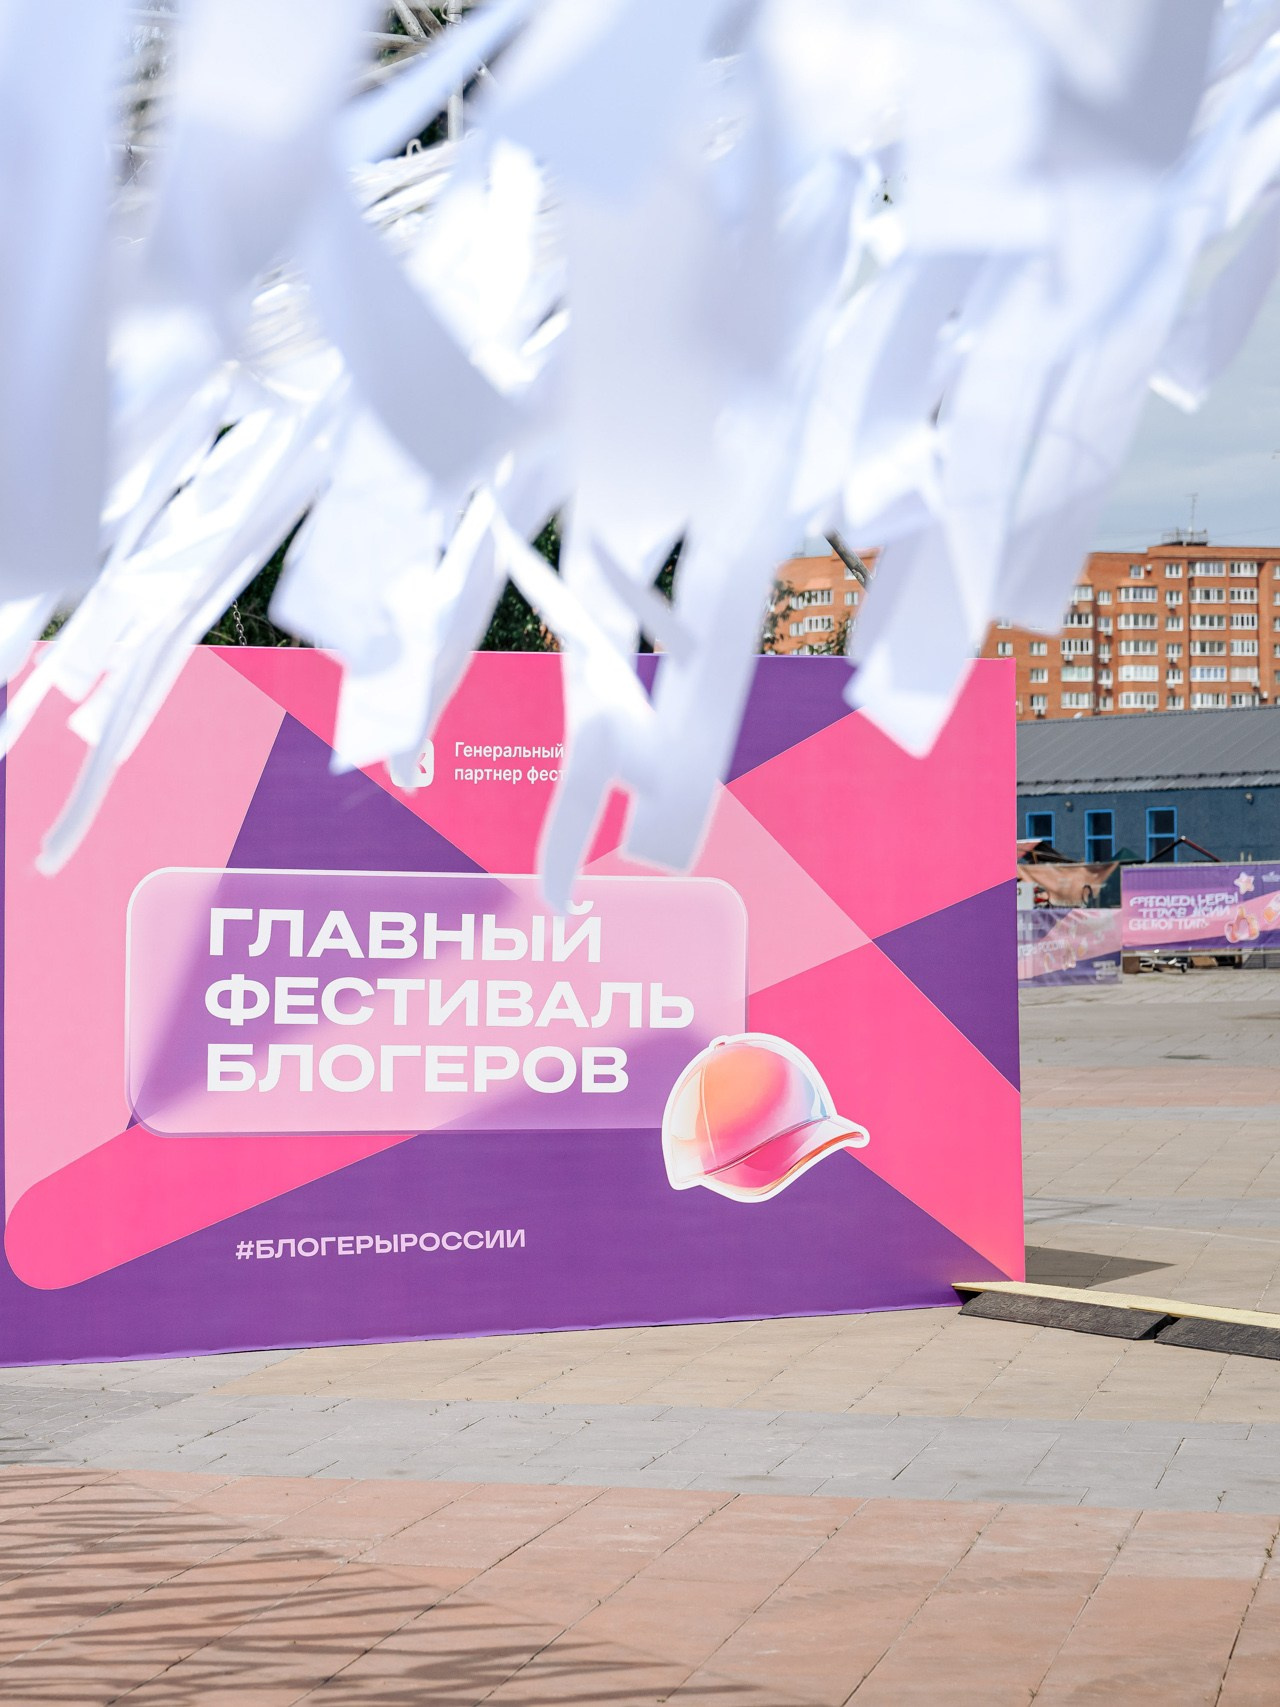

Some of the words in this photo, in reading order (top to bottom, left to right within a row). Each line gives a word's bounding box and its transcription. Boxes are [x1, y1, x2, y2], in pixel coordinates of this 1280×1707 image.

[455, 742, 565, 761] Генеральный
[454, 768, 523, 784] партнер
[527, 766, 567, 785] фест
[209, 899, 602, 963] ГЛАВНЫЙ
[204, 973, 695, 1029] ФЕСТИВАЛЬ
[206, 1043, 629, 1094] БЛОГЕРОВ
[235, 1229, 526, 1260] #БЛОГЕРЫРОССИИ
